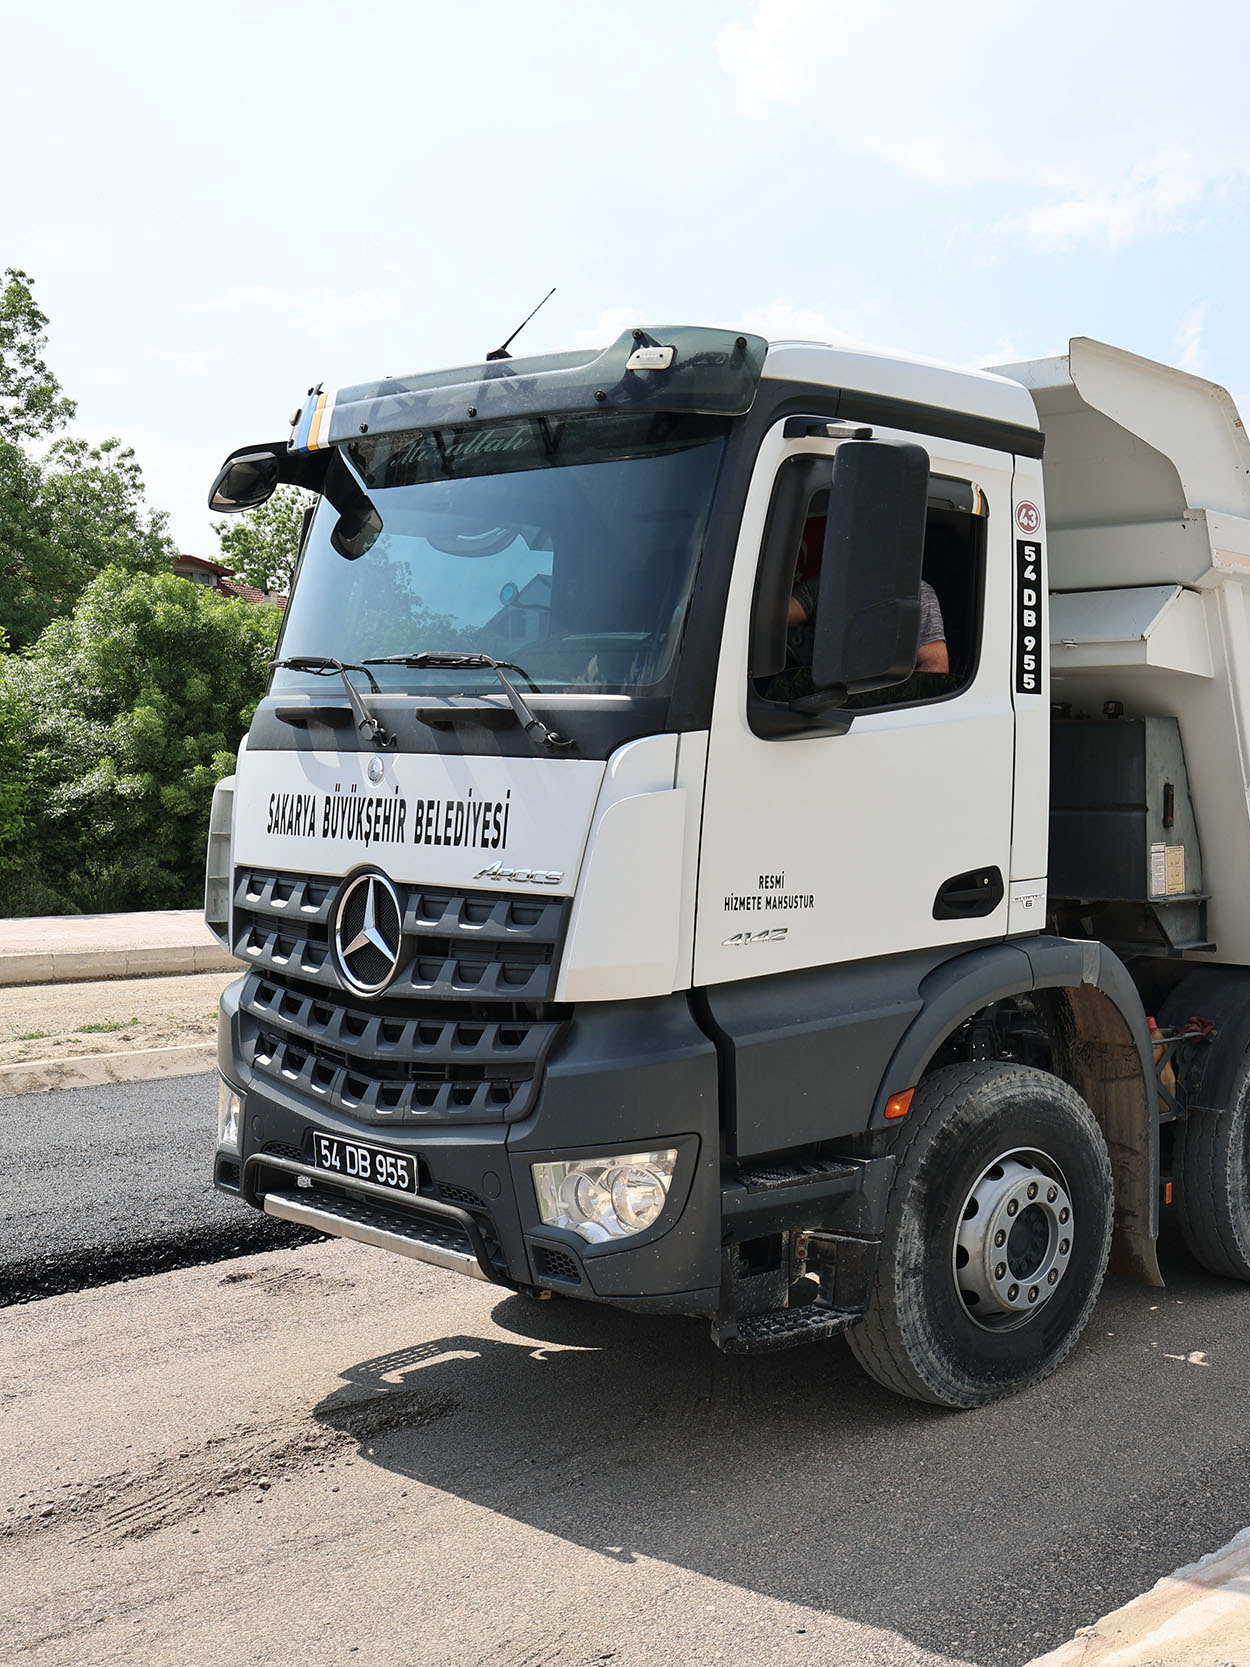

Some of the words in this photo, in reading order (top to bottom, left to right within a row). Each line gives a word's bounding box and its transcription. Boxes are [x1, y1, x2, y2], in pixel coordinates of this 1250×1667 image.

[1018, 508, 1037, 527] 43
[1023, 545, 1037, 581] 54
[1023, 588, 1037, 628] DB
[1023, 635, 1037, 690] 955
[267, 793, 316, 838] SAKARYA
[322, 784, 408, 848] BÜYÜKŞEHİR
[414, 788, 512, 849] BELEDİYESİ
[758, 871, 785, 889] RESMİ
[724, 892, 762, 911] HİZMETE
[765, 894, 815, 910] MAHSUSTUR
[721, 927, 789, 946] 4142
[320, 1139, 341, 1171] 54
[345, 1145, 371, 1178] DB
[376, 1154, 409, 1189] 955
